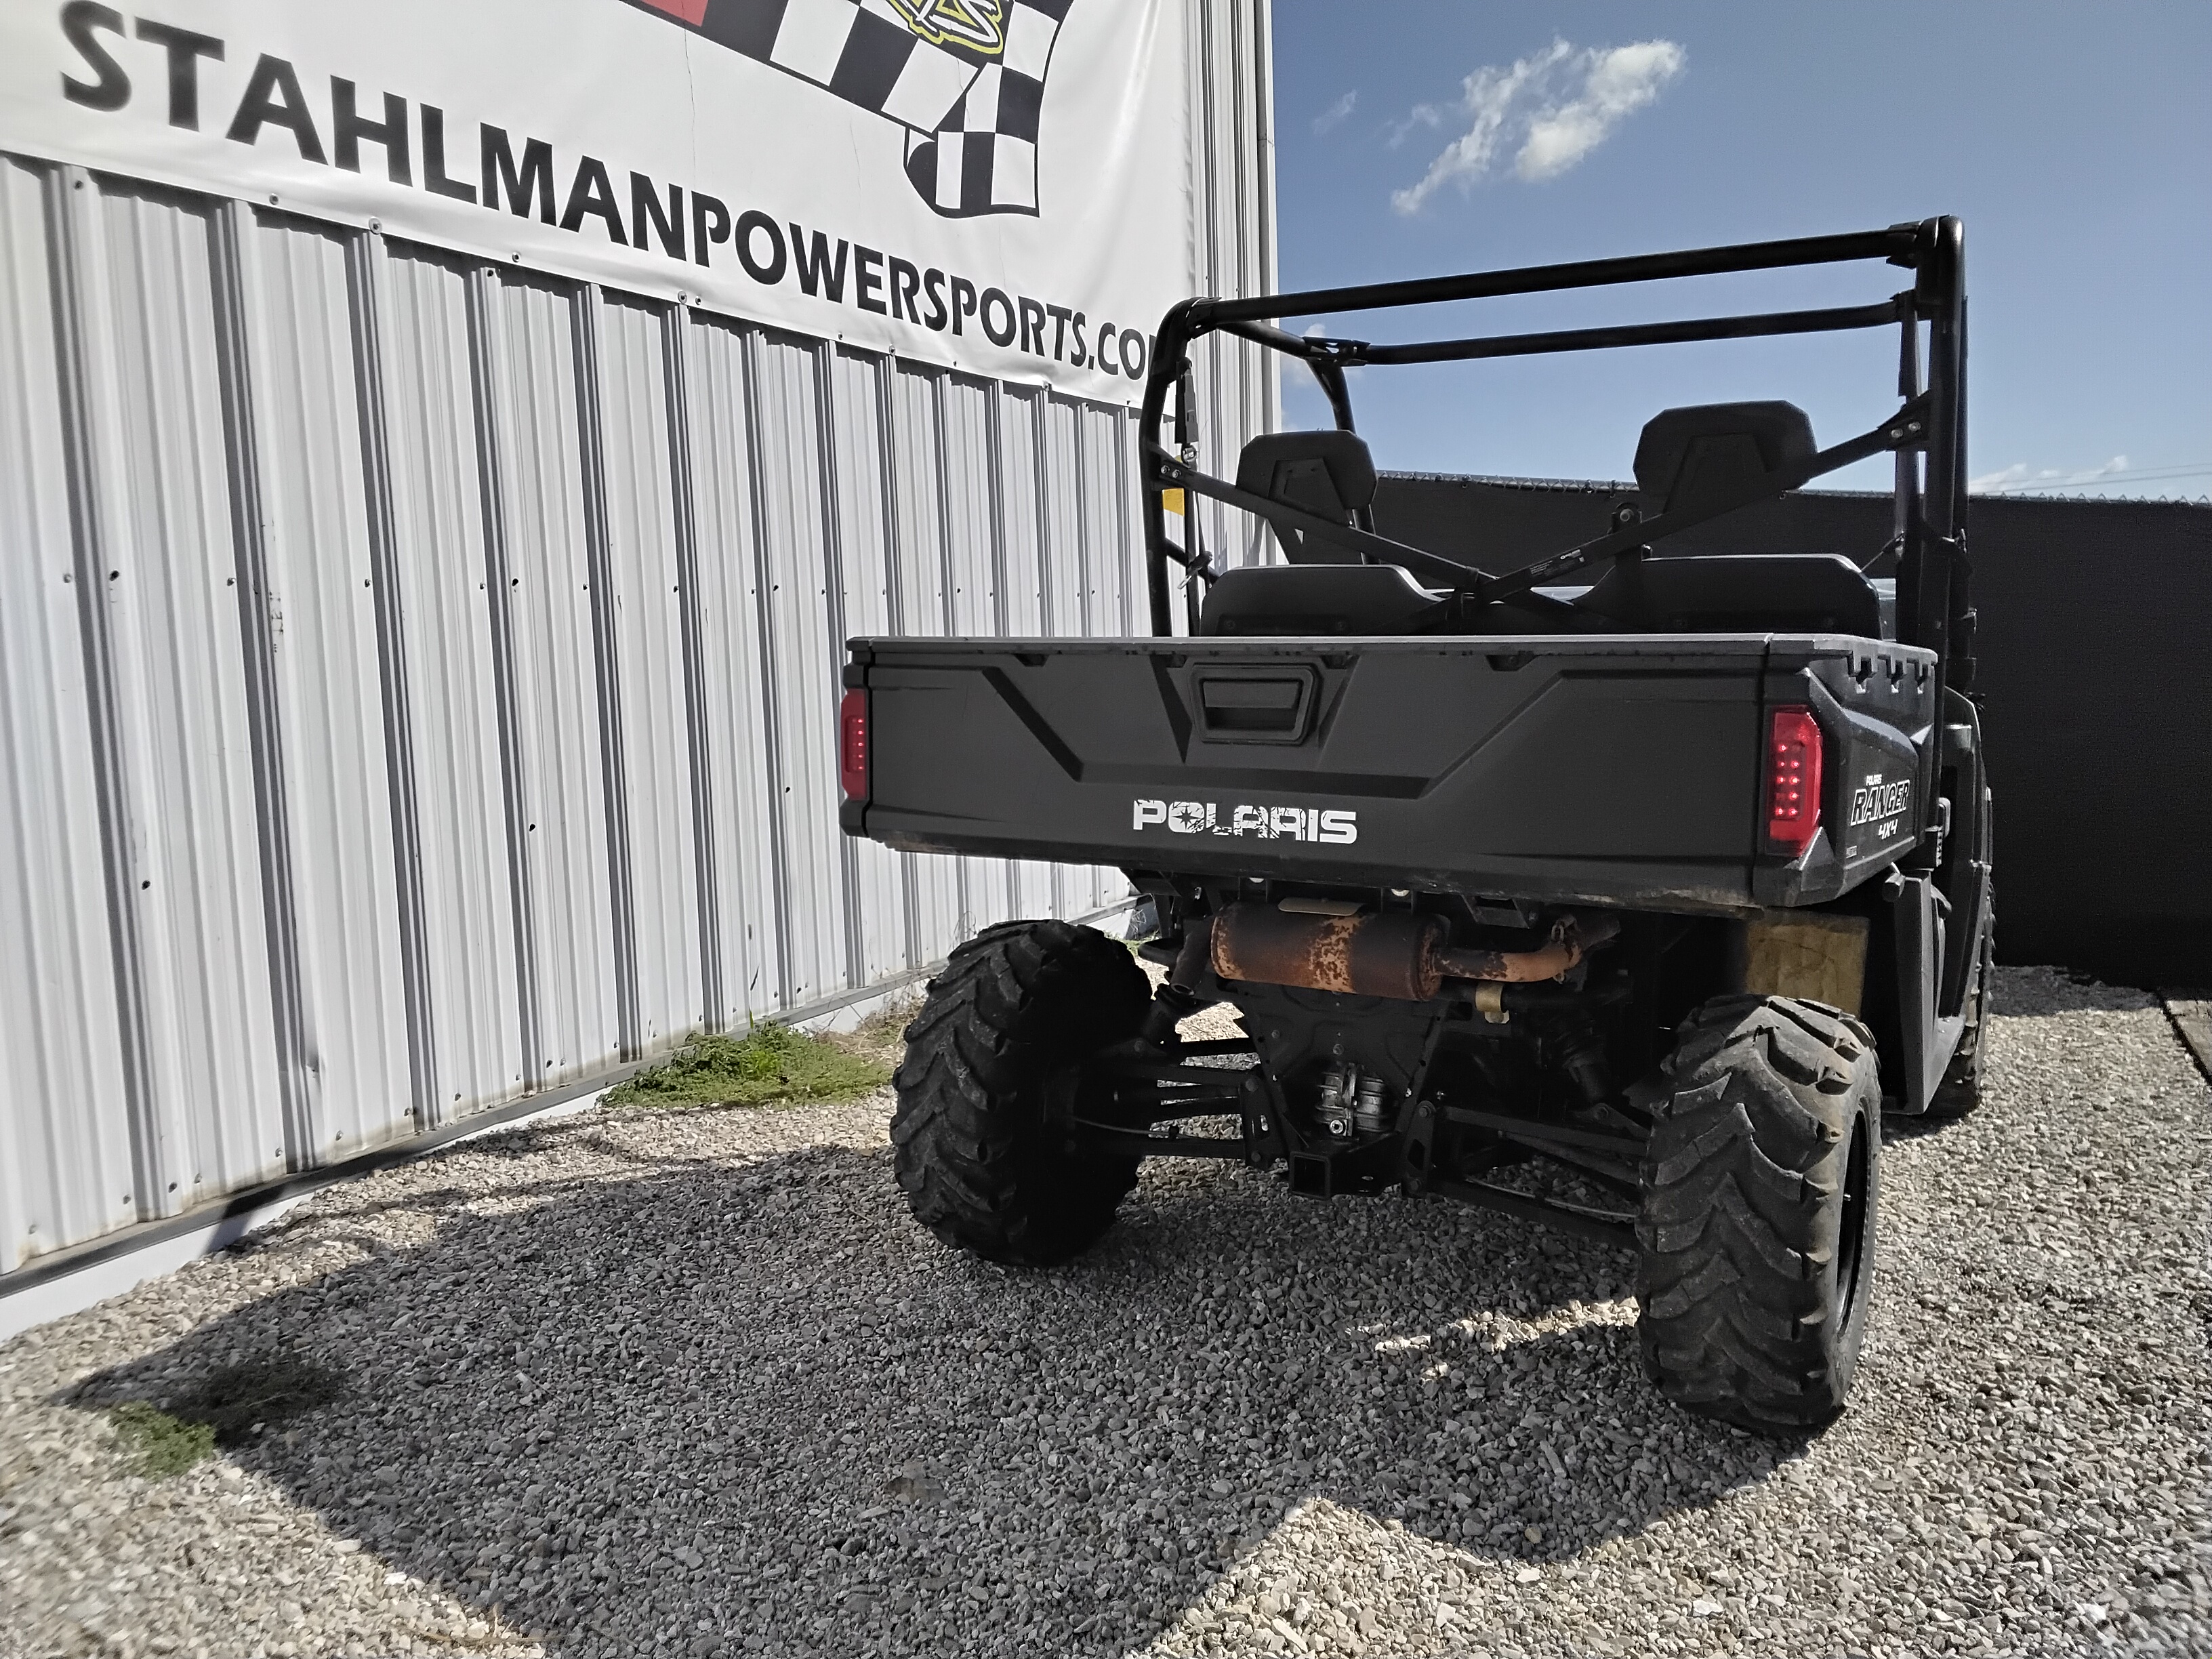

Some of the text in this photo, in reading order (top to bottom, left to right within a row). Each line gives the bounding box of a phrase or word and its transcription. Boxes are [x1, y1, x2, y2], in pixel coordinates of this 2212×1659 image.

[59, 0, 1156, 381] STAHLMANPOWERSPORTS.CO
[1133, 799, 1357, 844] POLARIS
[1850, 779, 1910, 826] RANGER
